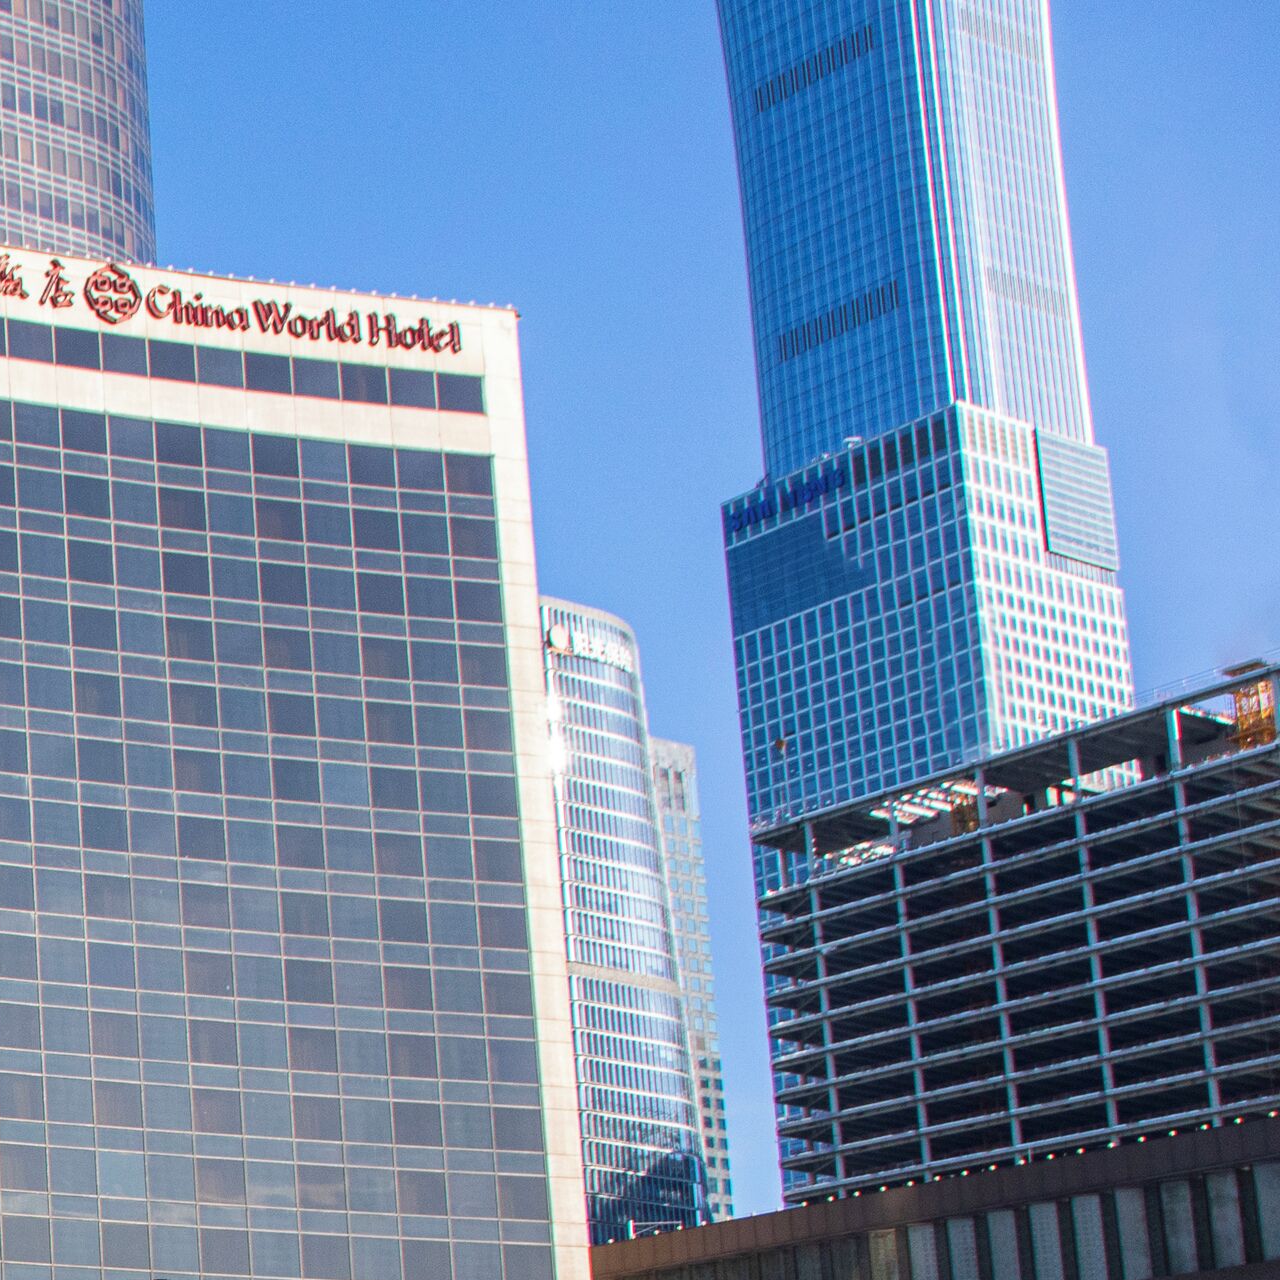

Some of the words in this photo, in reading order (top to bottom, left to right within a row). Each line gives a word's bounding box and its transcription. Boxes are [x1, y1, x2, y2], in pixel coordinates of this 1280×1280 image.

[145, 284, 250, 331] China
[253, 299, 362, 343] World
[368, 311, 463, 354] Hotel
